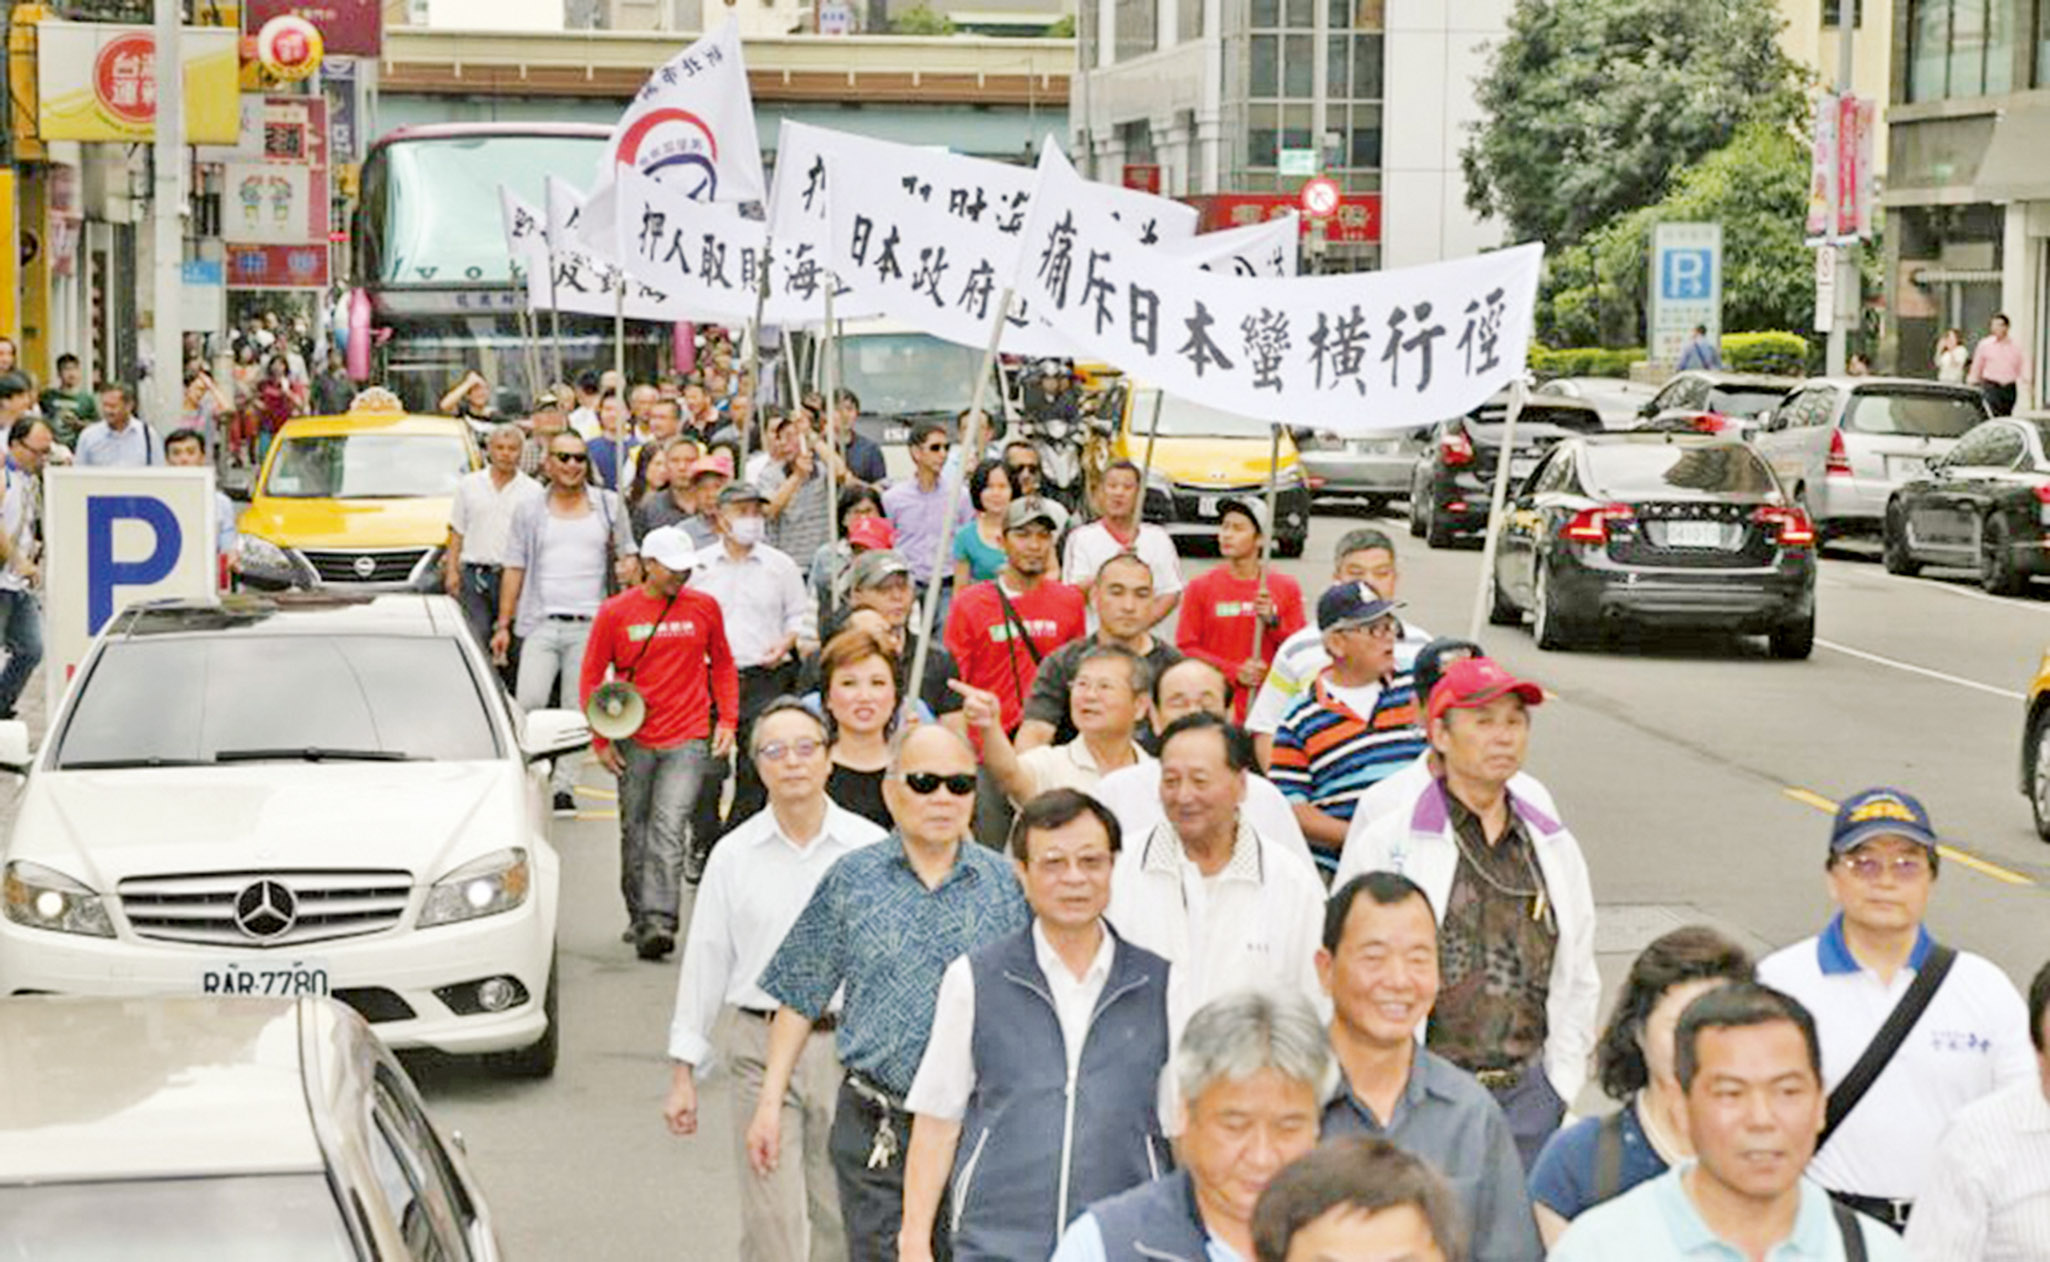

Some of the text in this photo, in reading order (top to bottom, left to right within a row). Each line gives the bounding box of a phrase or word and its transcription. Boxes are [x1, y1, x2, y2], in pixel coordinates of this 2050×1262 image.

[1036, 209, 1506, 396] 痛斥日本蠻橫行徑
[87, 495, 183, 637] P
